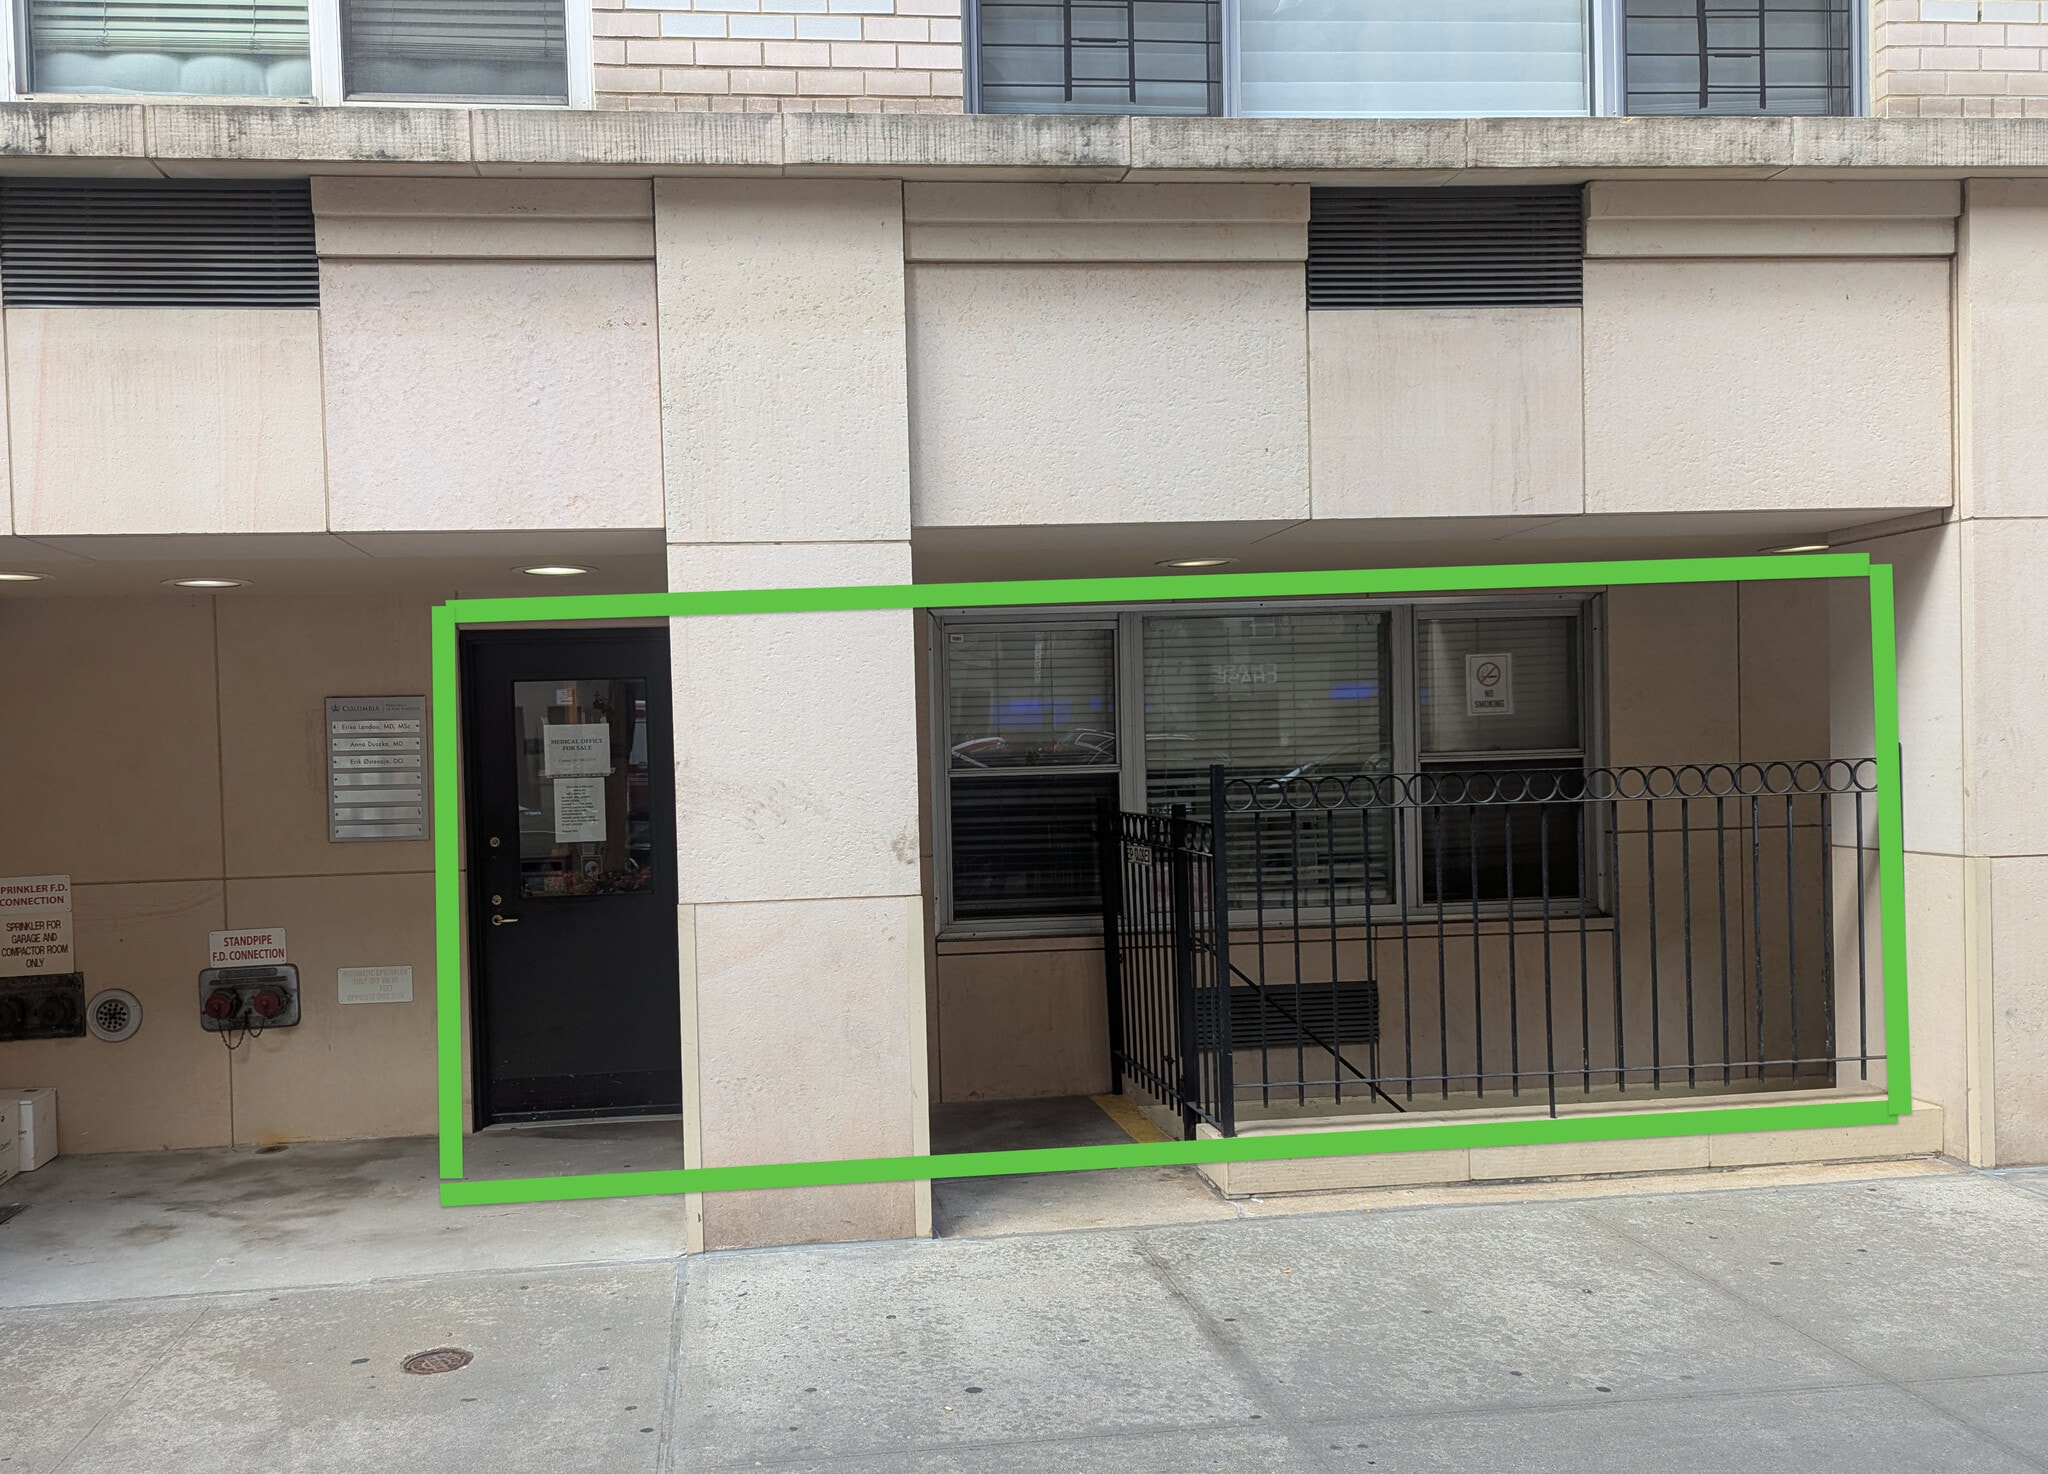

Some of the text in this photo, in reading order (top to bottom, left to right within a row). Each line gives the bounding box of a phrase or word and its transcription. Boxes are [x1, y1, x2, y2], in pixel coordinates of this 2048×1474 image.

[1485, 690, 1494, 698] NO
[1474, 700, 1504, 708] SMOKING
[358, 723, 382, 731] Landau,
[0, 883, 68, 894] PRINKLER F.D.
[0, 896, 64, 906] CONNECTION
[6, 920, 61, 932] SPRINKLER FOR
[11, 932, 57, 944] GARAGE AND
[223, 934, 272, 947] STANDPIPE
[1, 944, 68, 957] COMPACTOR ROOM
[212, 948, 285, 962] F.D. CONNECTION
[26, 958, 45, 968] ONLY
